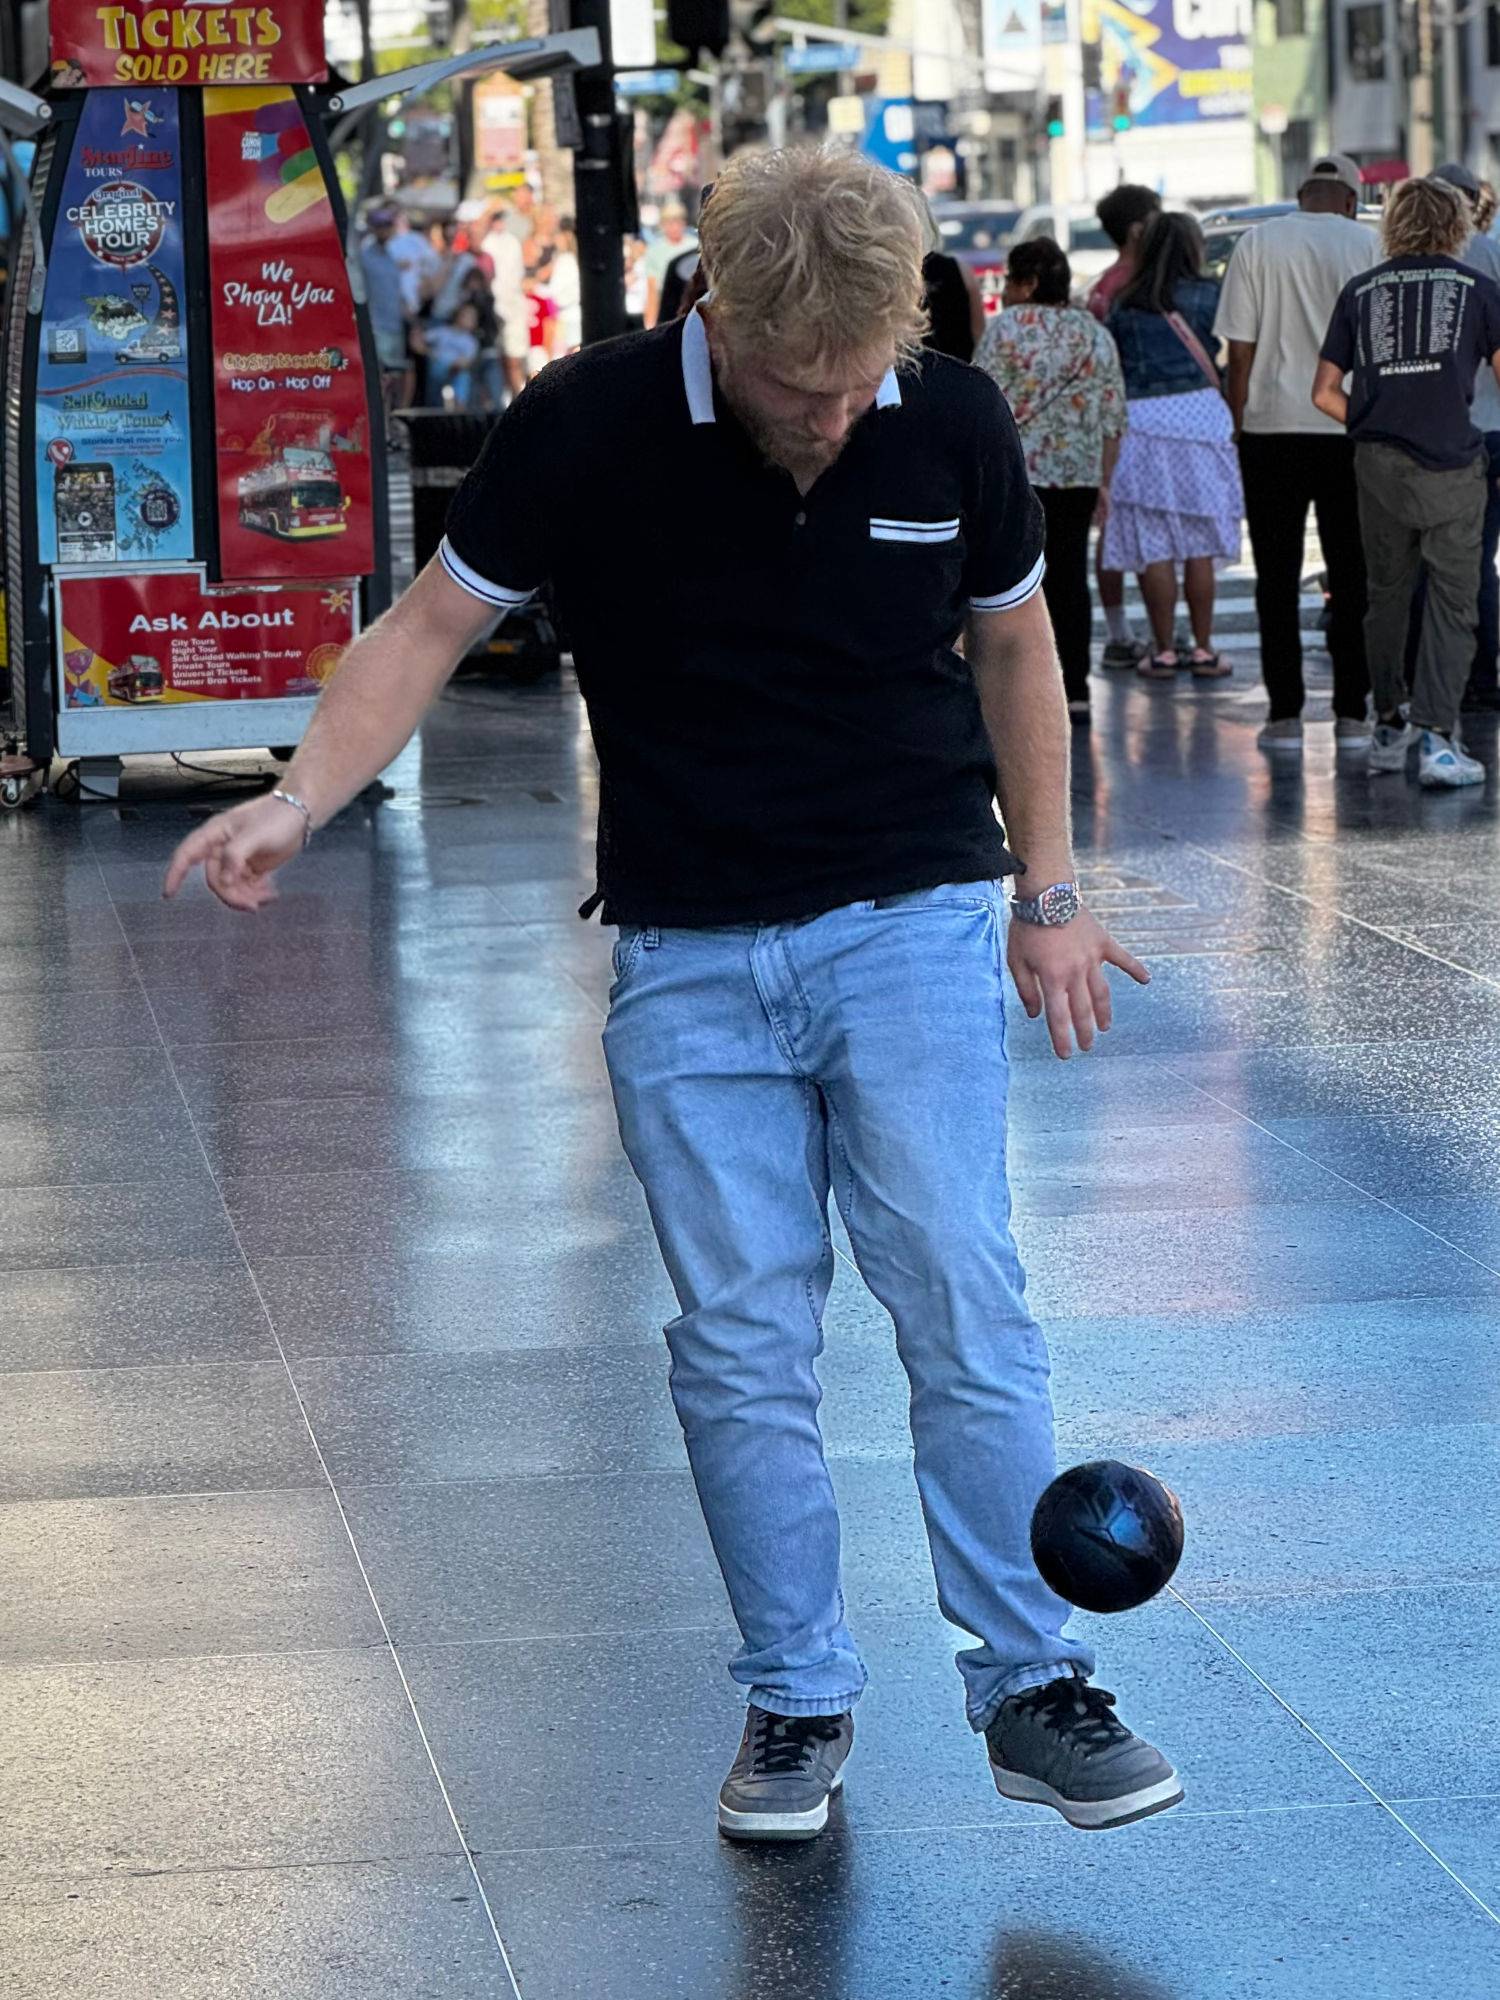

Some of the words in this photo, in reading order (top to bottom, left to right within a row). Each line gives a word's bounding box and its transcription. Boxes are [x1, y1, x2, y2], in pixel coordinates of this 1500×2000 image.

[96, 6, 281, 49] TICKETS
[114, 53, 189, 82] SOLD
[198, 53, 273, 81] HERE
[84, 167, 123, 177] TOURS
[92, 186, 143, 203] Original
[66, 201, 176, 221] CELEBRITY
[84, 216, 159, 235] HOMES
[93, 231, 151, 248] TOUR
[262, 260, 293, 282] We
[223, 281, 283, 307] Show
[291, 281, 335, 310] You
[257, 302, 292, 326] LA!
[1379, 362, 1442, 376] SEAHAWKS
[231, 377, 256, 392] Hop
[258, 376, 276, 391] On
[285, 374, 309, 390] Hop
[312, 373, 332, 389] Off
[115, 437, 134, 445] that
[129, 612, 188, 633] Ask
[198, 608, 294, 630] About
[171, 639, 189, 648] City
[191, 637, 215, 646] Tours
[172, 646, 195, 656] Night
[198, 645, 218, 653] Tour
[172, 654, 190, 663] Self
[191, 652, 224, 662] Guided
[225, 650, 260, 661] Walking
[263, 649, 283, 659] Tour
[284, 648, 302, 659] App
[172, 662, 204, 671] Private
[206, 661, 230, 669] Tours
[172, 670, 214, 679] Universal
[217, 668, 248, 677] Tickets
[173, 678, 205, 687] Warner
[207, 676, 228, 685] Bros
[230, 675, 262, 684] Tickets
